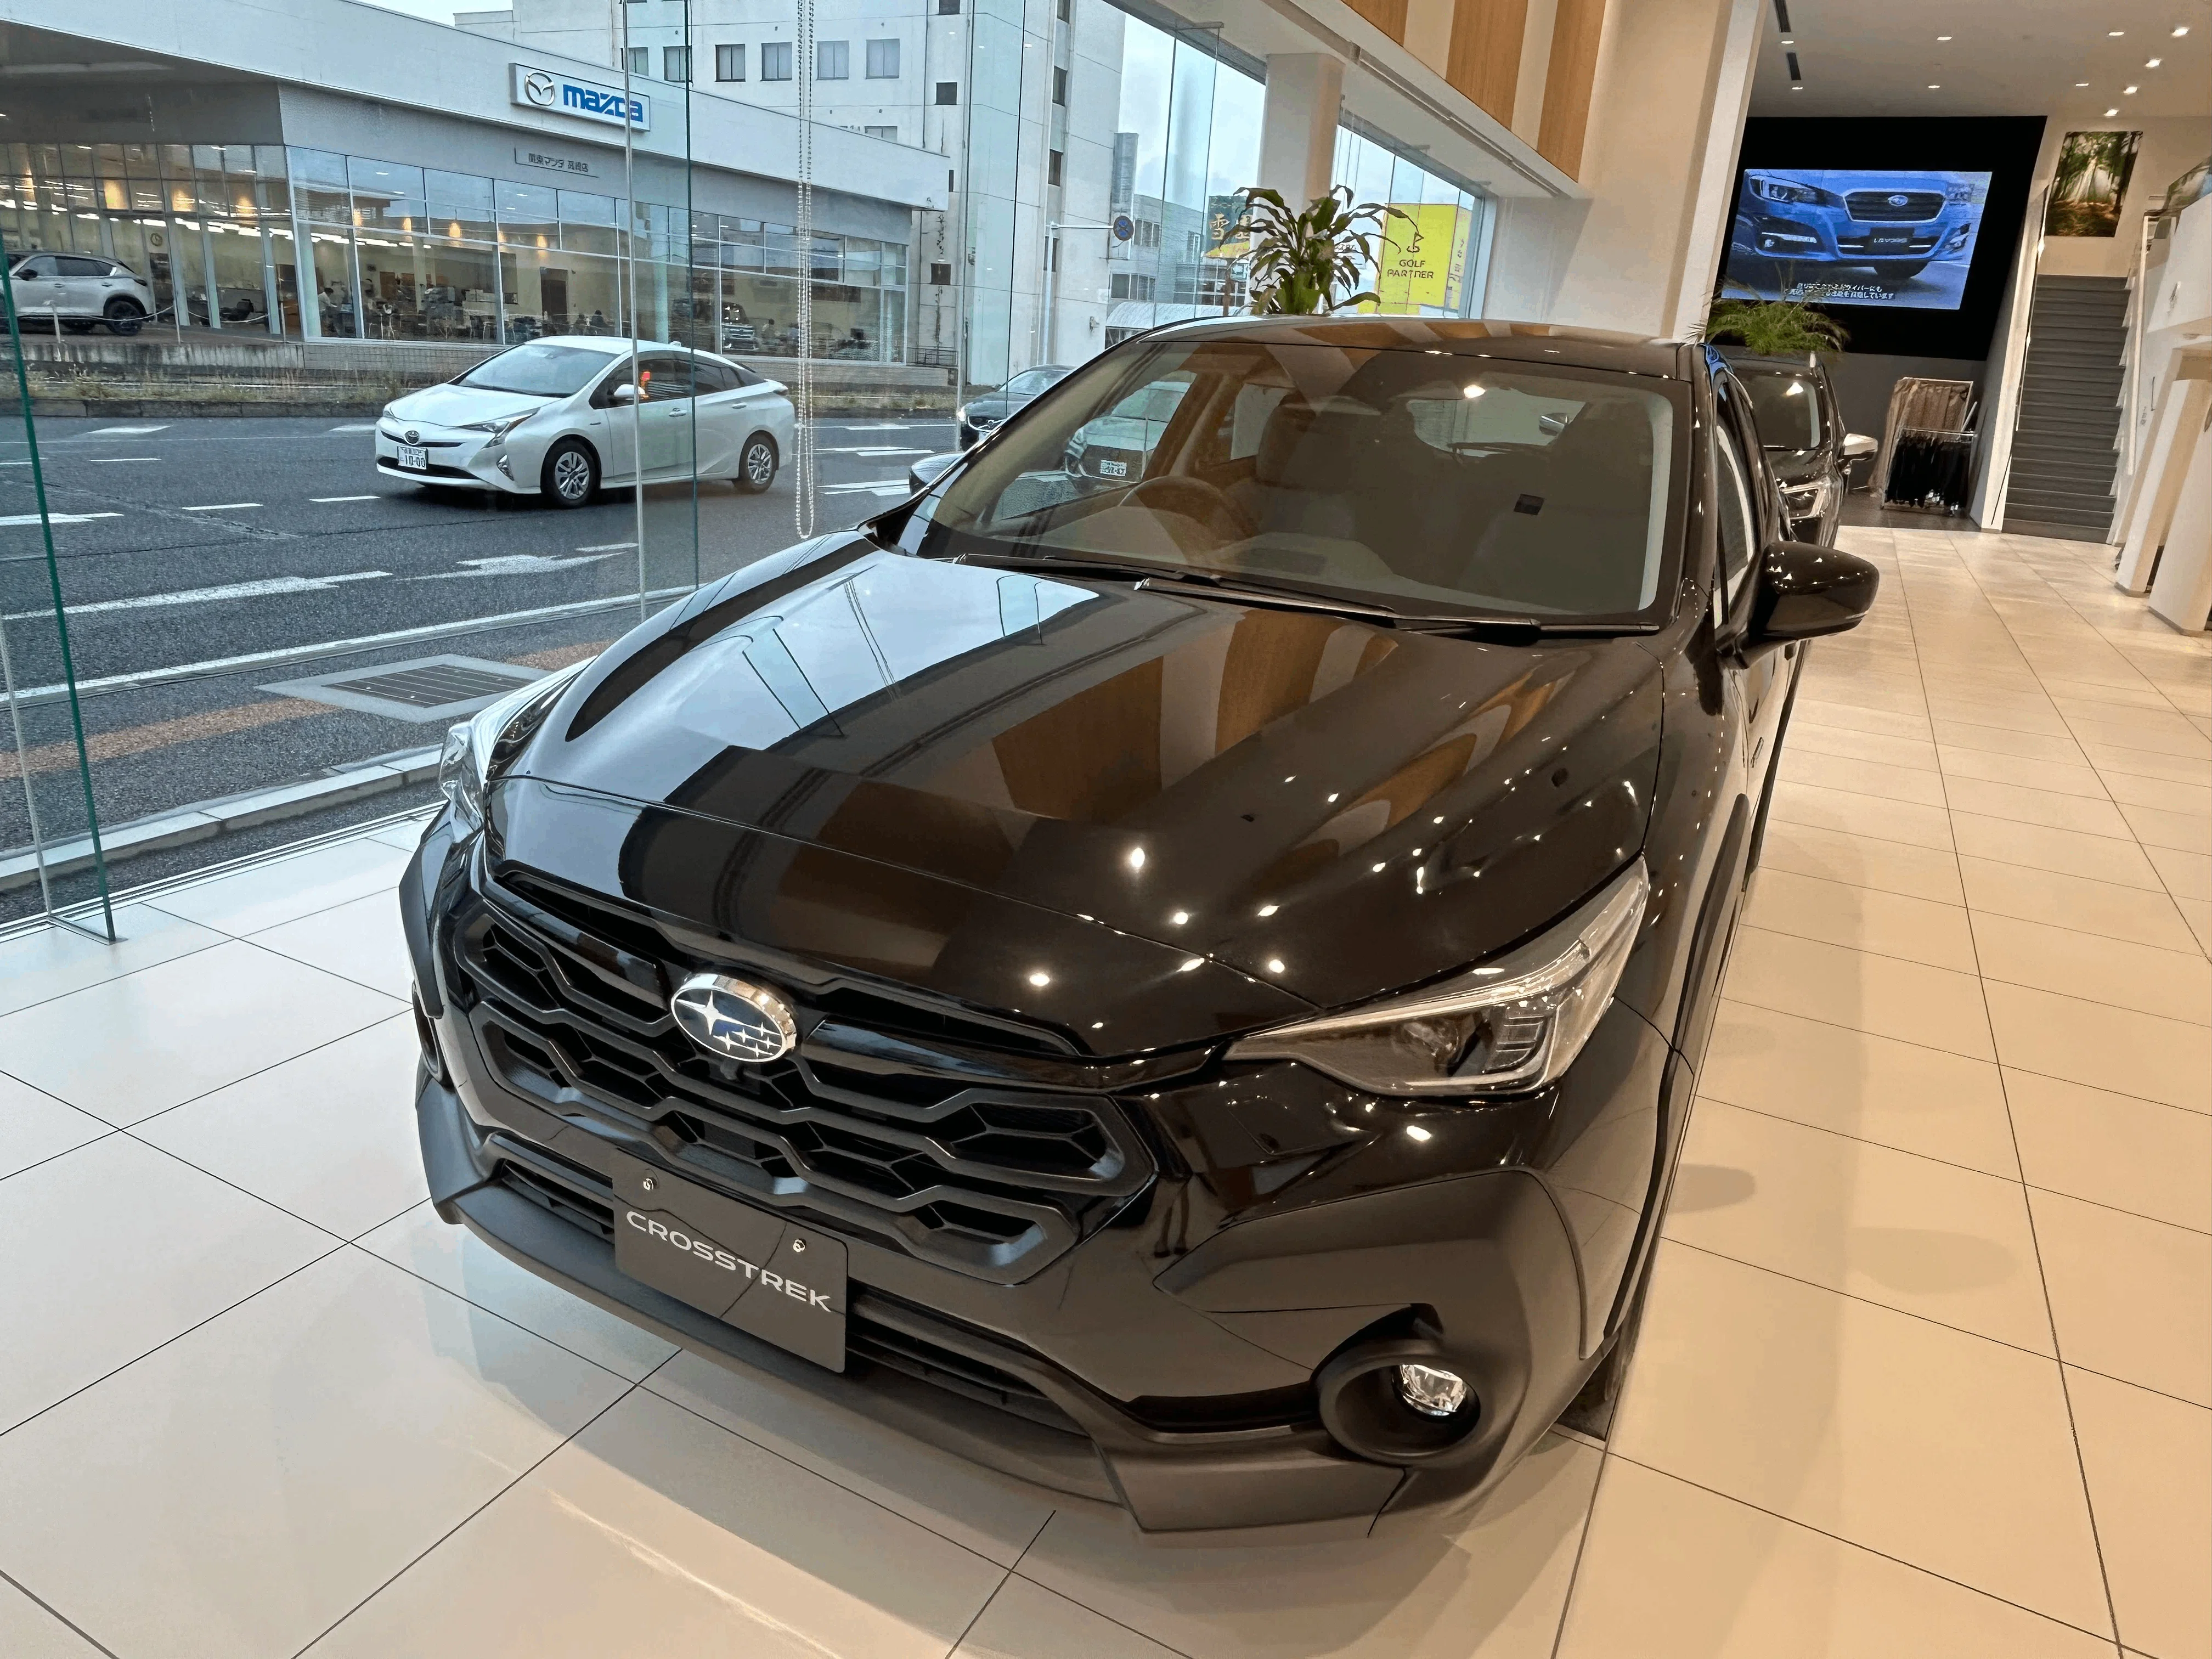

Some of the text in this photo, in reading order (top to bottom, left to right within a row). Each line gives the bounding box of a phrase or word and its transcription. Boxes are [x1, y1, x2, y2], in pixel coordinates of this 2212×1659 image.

[563, 84, 643, 122] mazda
[1387, 269, 1434, 279] PARTNER
[1400, 259, 1426, 268] GOLF
[627, 1210, 832, 1312] CROSSTREK
